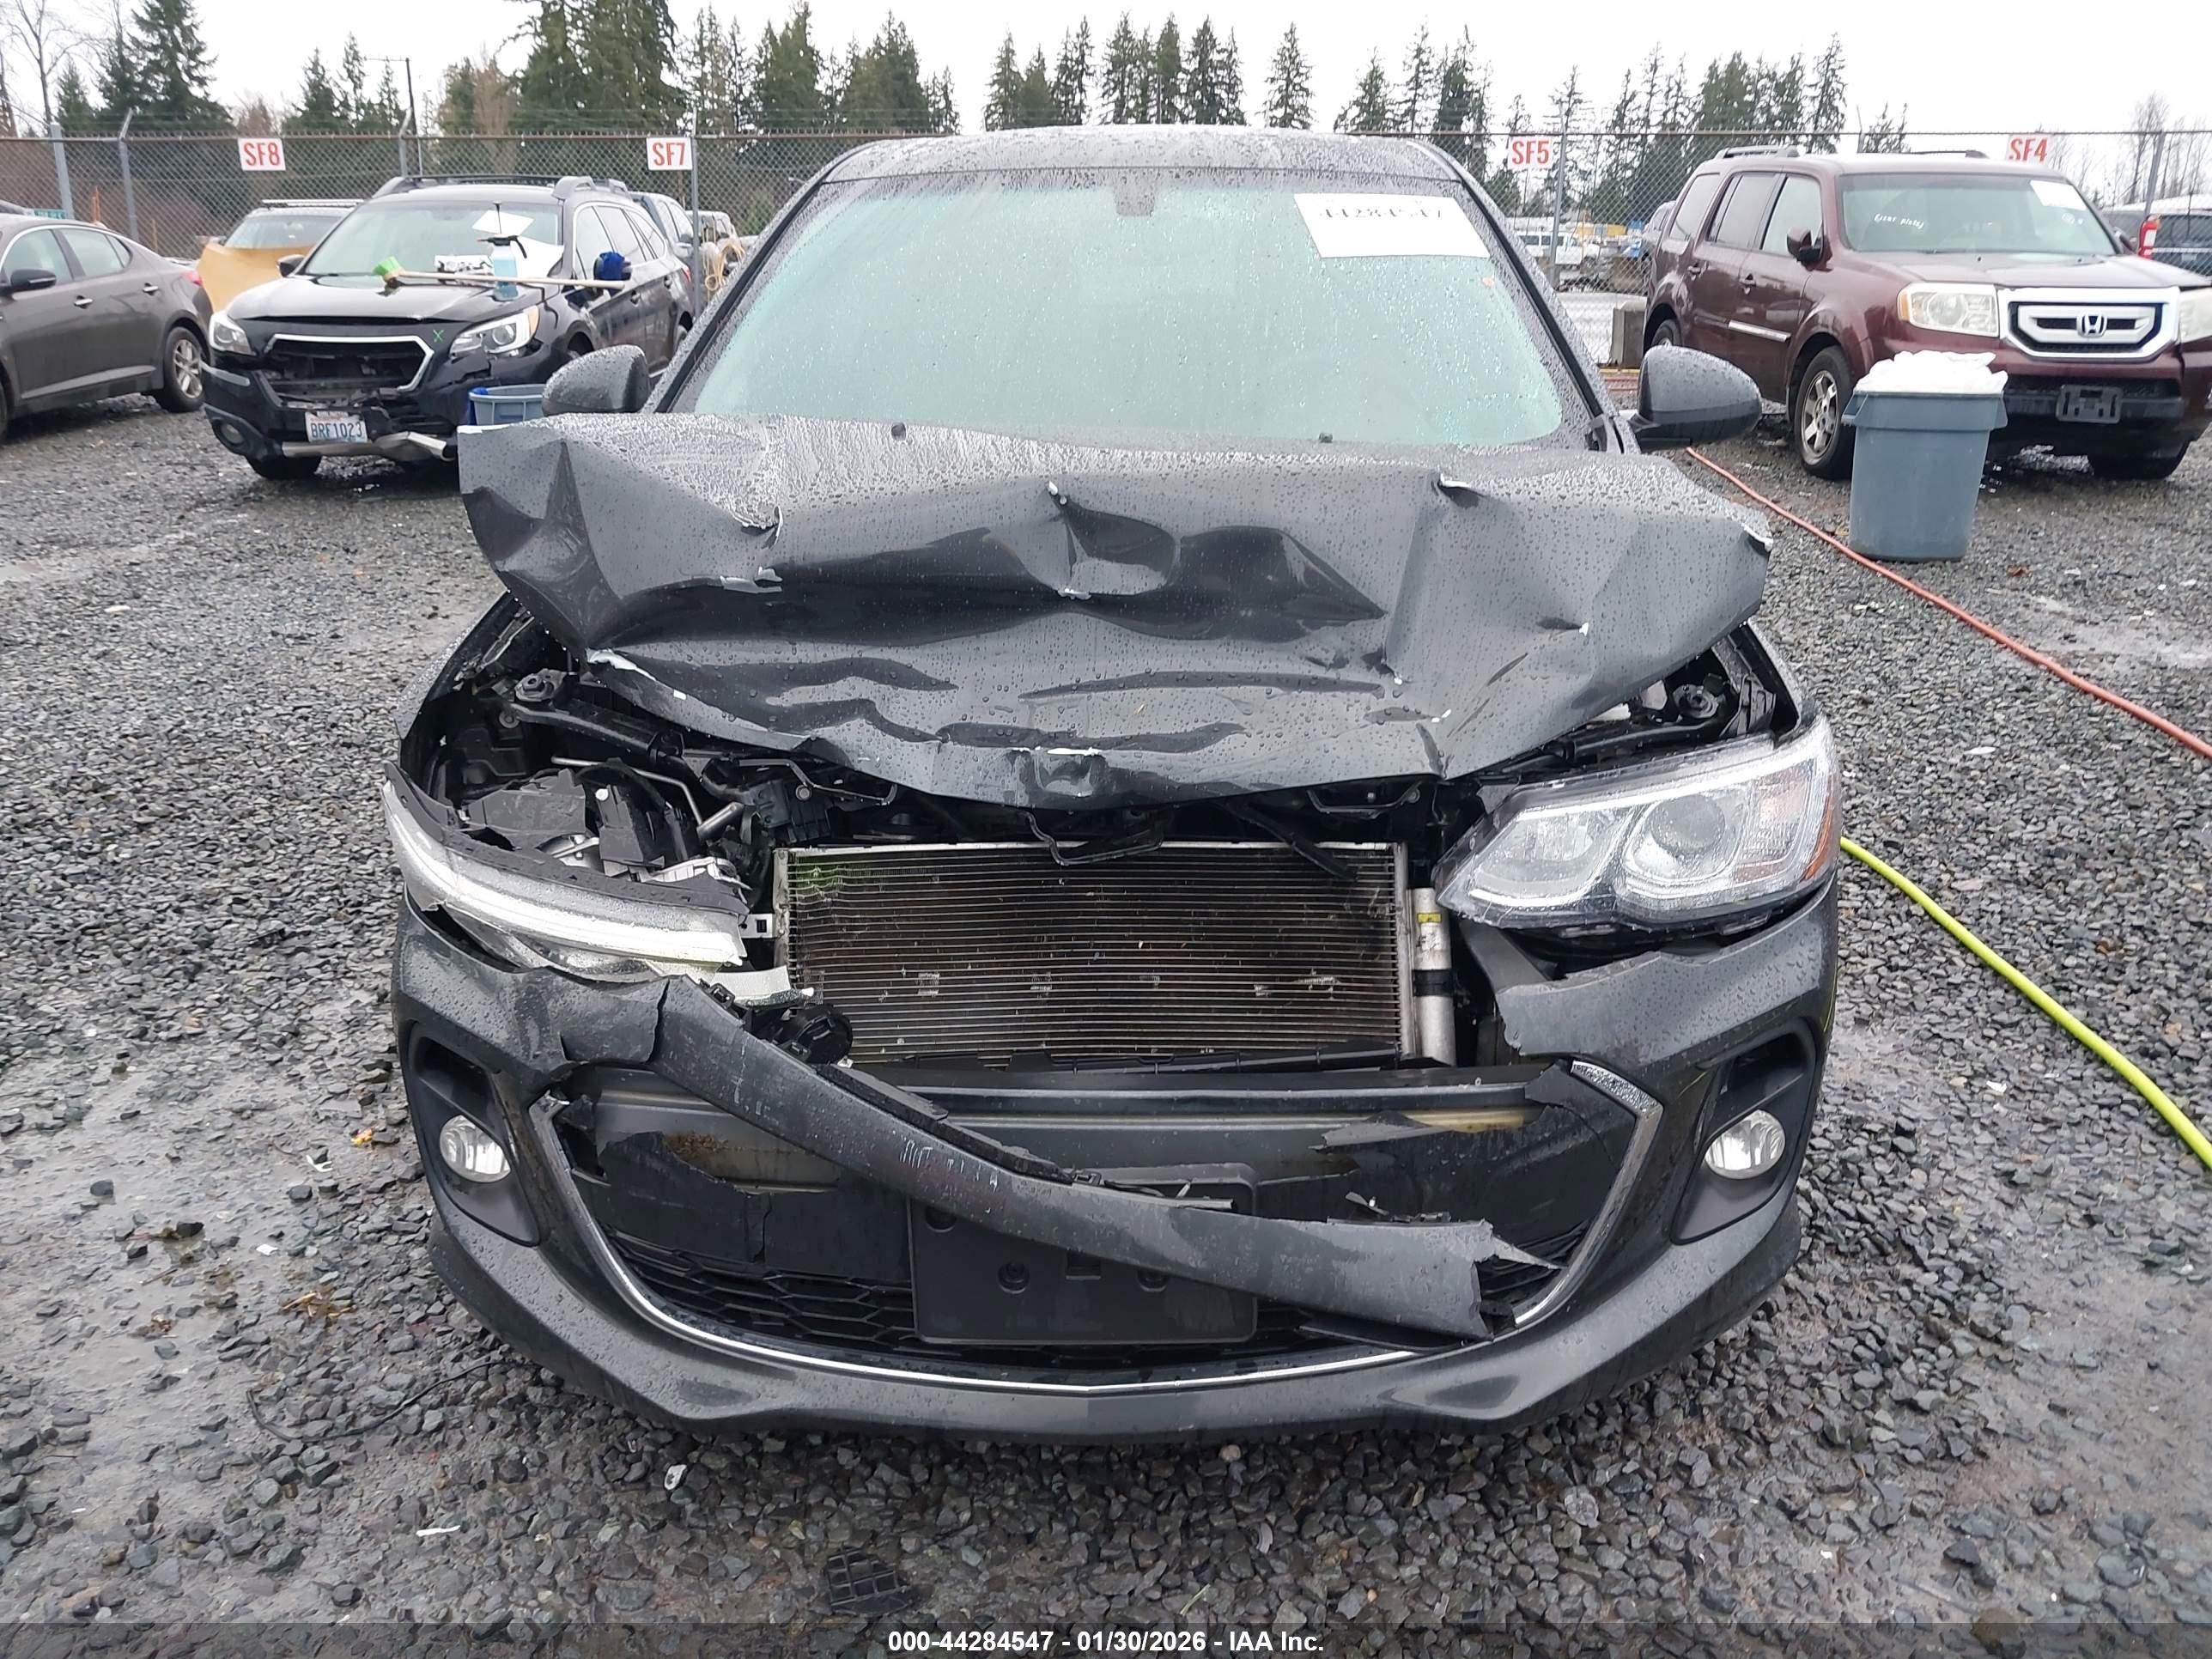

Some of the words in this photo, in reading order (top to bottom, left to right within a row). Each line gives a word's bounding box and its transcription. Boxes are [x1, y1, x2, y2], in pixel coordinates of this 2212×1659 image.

[244, 143, 280, 166] SF8
[653, 143, 685, 166] SF7
[1512, 141, 1549, 164] SF5
[2009, 138, 2048, 162] SF4
